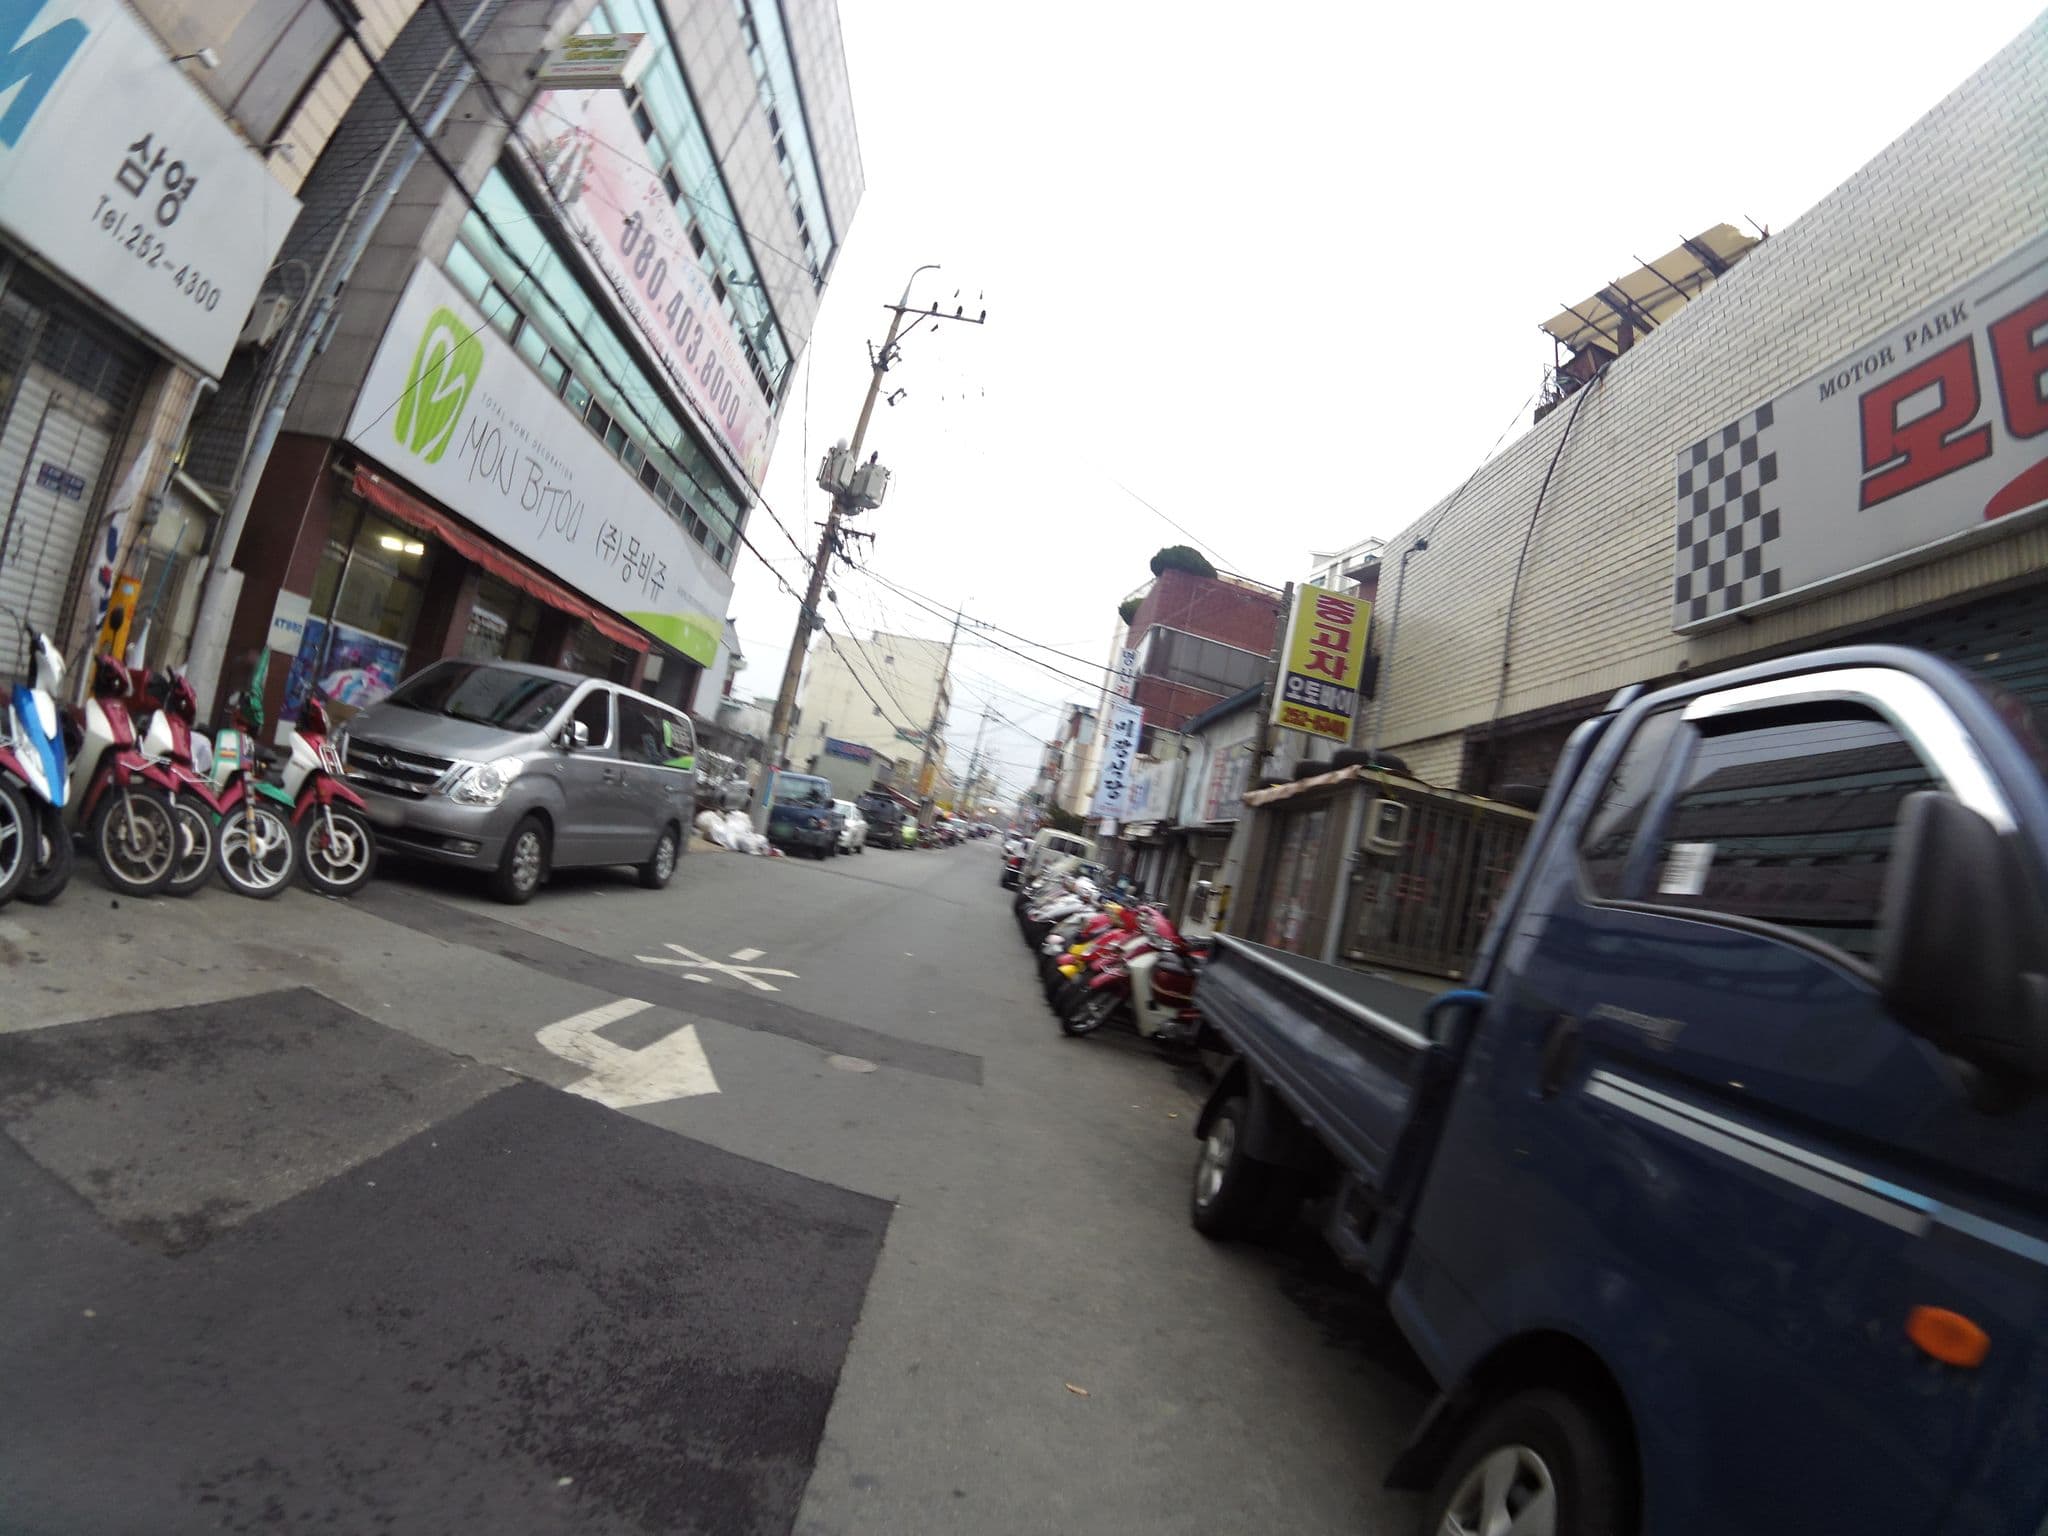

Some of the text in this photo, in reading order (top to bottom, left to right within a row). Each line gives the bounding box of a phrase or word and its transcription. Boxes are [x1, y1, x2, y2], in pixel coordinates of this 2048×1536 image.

[114, 132, 198, 227] 삼영
[620, 210, 740, 430] 080.403.8000
[1818, 302, 1969, 403] MOTOR PARK
[457, 415, 519, 496] MON
[1304, 594, 1356, 682] 중고차
[1285, 675, 1358, 716] 오토바이
